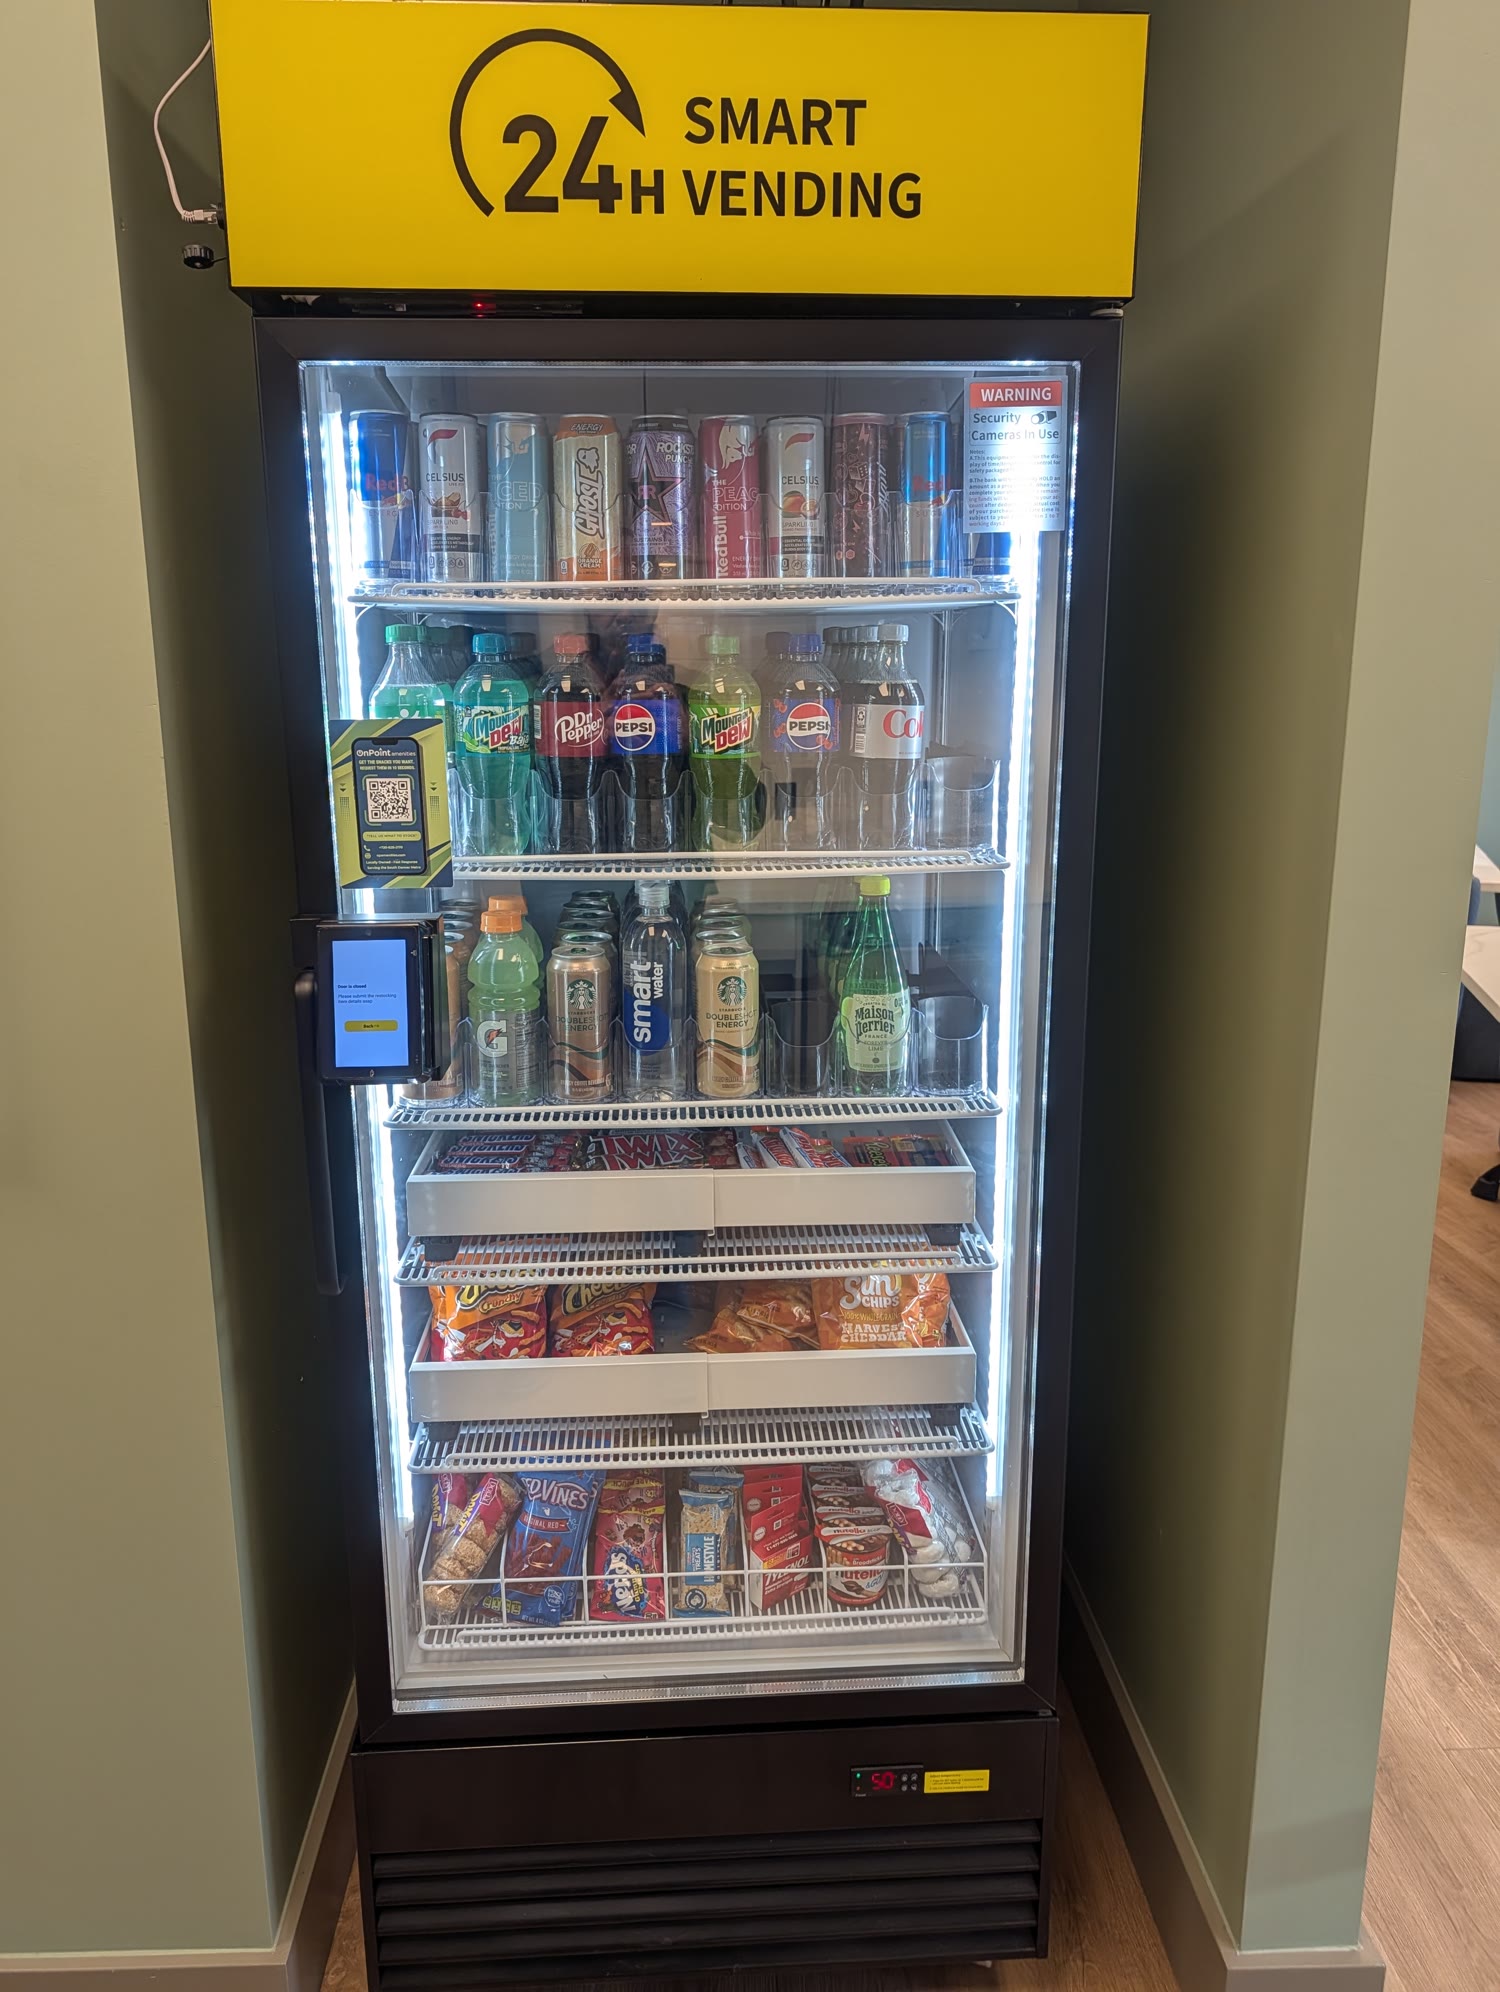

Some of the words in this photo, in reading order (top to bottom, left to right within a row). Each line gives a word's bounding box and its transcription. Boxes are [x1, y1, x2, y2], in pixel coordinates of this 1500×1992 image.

[683, 96, 867, 147] SMART
[683, 169, 923, 220] VENDING
[980, 387, 1052, 402] WARNING
[973, 412, 1022, 425] Security
[971, 430, 1021, 441] Cameras
[1025, 429, 1035, 440] In
[1039, 429, 1060, 440] Use
[656, 443, 695, 454] ROCKST
[426, 472, 465, 483] CELSIUS
[781, 476, 819, 485] CELSIUS
[575, 460, 606, 541] GHOST
[712, 486, 759, 502] PEAC
[564, 711, 593, 729] Dr
[615, 721, 653, 733] PEPSI
[789, 720, 829, 732] PEPSI
[882, 708, 925, 739] Cok
[556, 716, 603, 744] Pepper
[356, 747, 391, 757] OnPoint
[651, 962, 664, 1000] water
[630, 959, 652, 1044] smart
[705, 1010, 758, 1021] DOUBLESHOT
[855, 1005, 895, 1022] Maison
[564, 1023, 598, 1032] ENERGY
[715, 1020, 749, 1029] ENERGY
[855, 1018, 897, 1044] Perrier
[477, 1019, 508, 1058] G
[840, 1274, 902, 1310] Sun
[861, 1296, 900, 1309] CHIPS
[841, 1322, 906, 1334] HARVEST
[841, 1331, 907, 1343] CHEDDAR
[542, 1479, 589, 1510] VINES
[523, 1514, 546, 1527] OIGINAL
[704, 1535, 715, 1583] HMESTYLE
